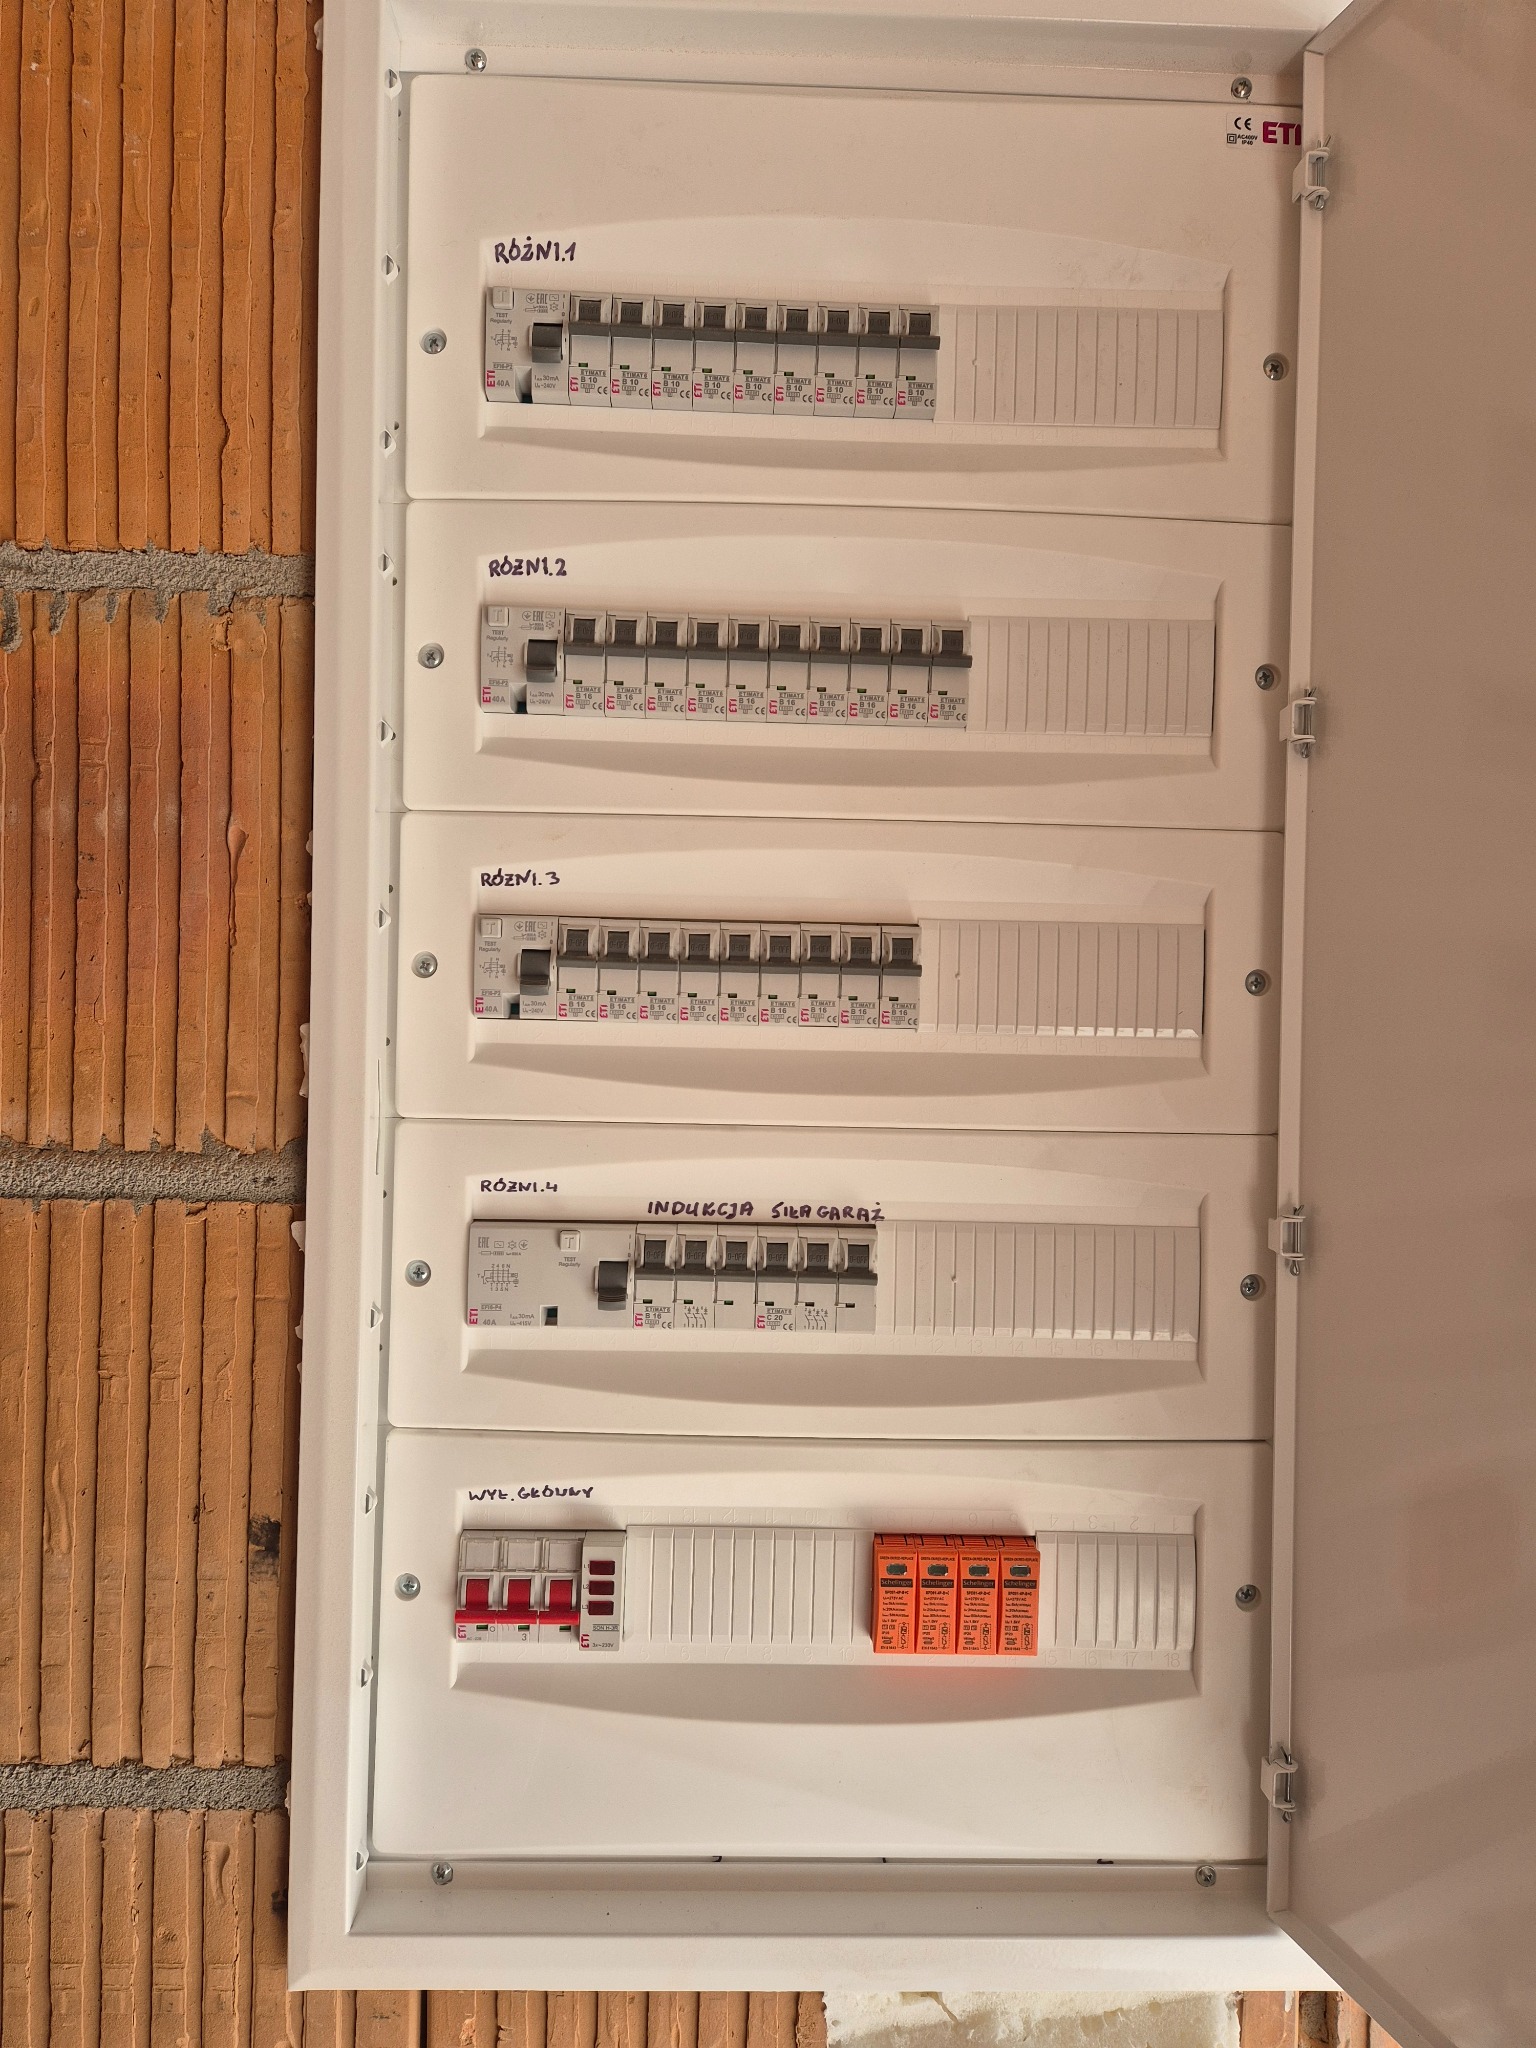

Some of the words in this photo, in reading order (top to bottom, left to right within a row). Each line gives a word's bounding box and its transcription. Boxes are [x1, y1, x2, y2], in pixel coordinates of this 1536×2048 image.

[1262, 121, 1302, 146] ETI
[486, 370, 495, 388] ETI
[570, 377, 579, 392] ETI
[611, 380, 620, 395] ETI
[652, 381, 661, 397] ETI
[693, 384, 702, 399] ETI
[734, 385, 743, 400] ETI
[774, 386, 784, 403] ETI
[816, 388, 824, 404] ETI
[855, 389, 864, 405] ETI
[896, 391, 906, 406] ETI
[482, 686, 491, 703] ETI
[564, 694, 574, 709] ETI
[605, 696, 616, 711] ETI
[646, 698, 656, 712] ETI
[687, 698, 696, 713] ETI
[728, 699, 736, 715] ETI
[768, 700, 778, 715] ETI
[808, 701, 817, 717] ETI
[848, 704, 858, 718] ETI
[889, 704, 898, 719] ETI
[930, 704, 938, 719] ETI
[475, 997, 484, 1013] ETI
[557, 1003, 567, 1018] ETI
[598, 1004, 608, 1019] ETI
[639, 1006, 648, 1020] ETI
[679, 1008, 688, 1021] ETI
[720, 1008, 728, 1022] ETI
[760, 1009, 768, 1023] ETI
[800, 1008, 810, 1023] ETI
[840, 1010, 848, 1024] ETI
[880, 1010, 890, 1025] ETI
[647, 1201, 754, 1219] INDUKCJA
[469, 1308, 478, 1325] ETI
[634, 1313, 643, 1328] ETI
[756, 1315, 765, 1329] ETI
[458, 1625, 466, 1639] ETI
[580, 1634, 589, 1648] ETI
